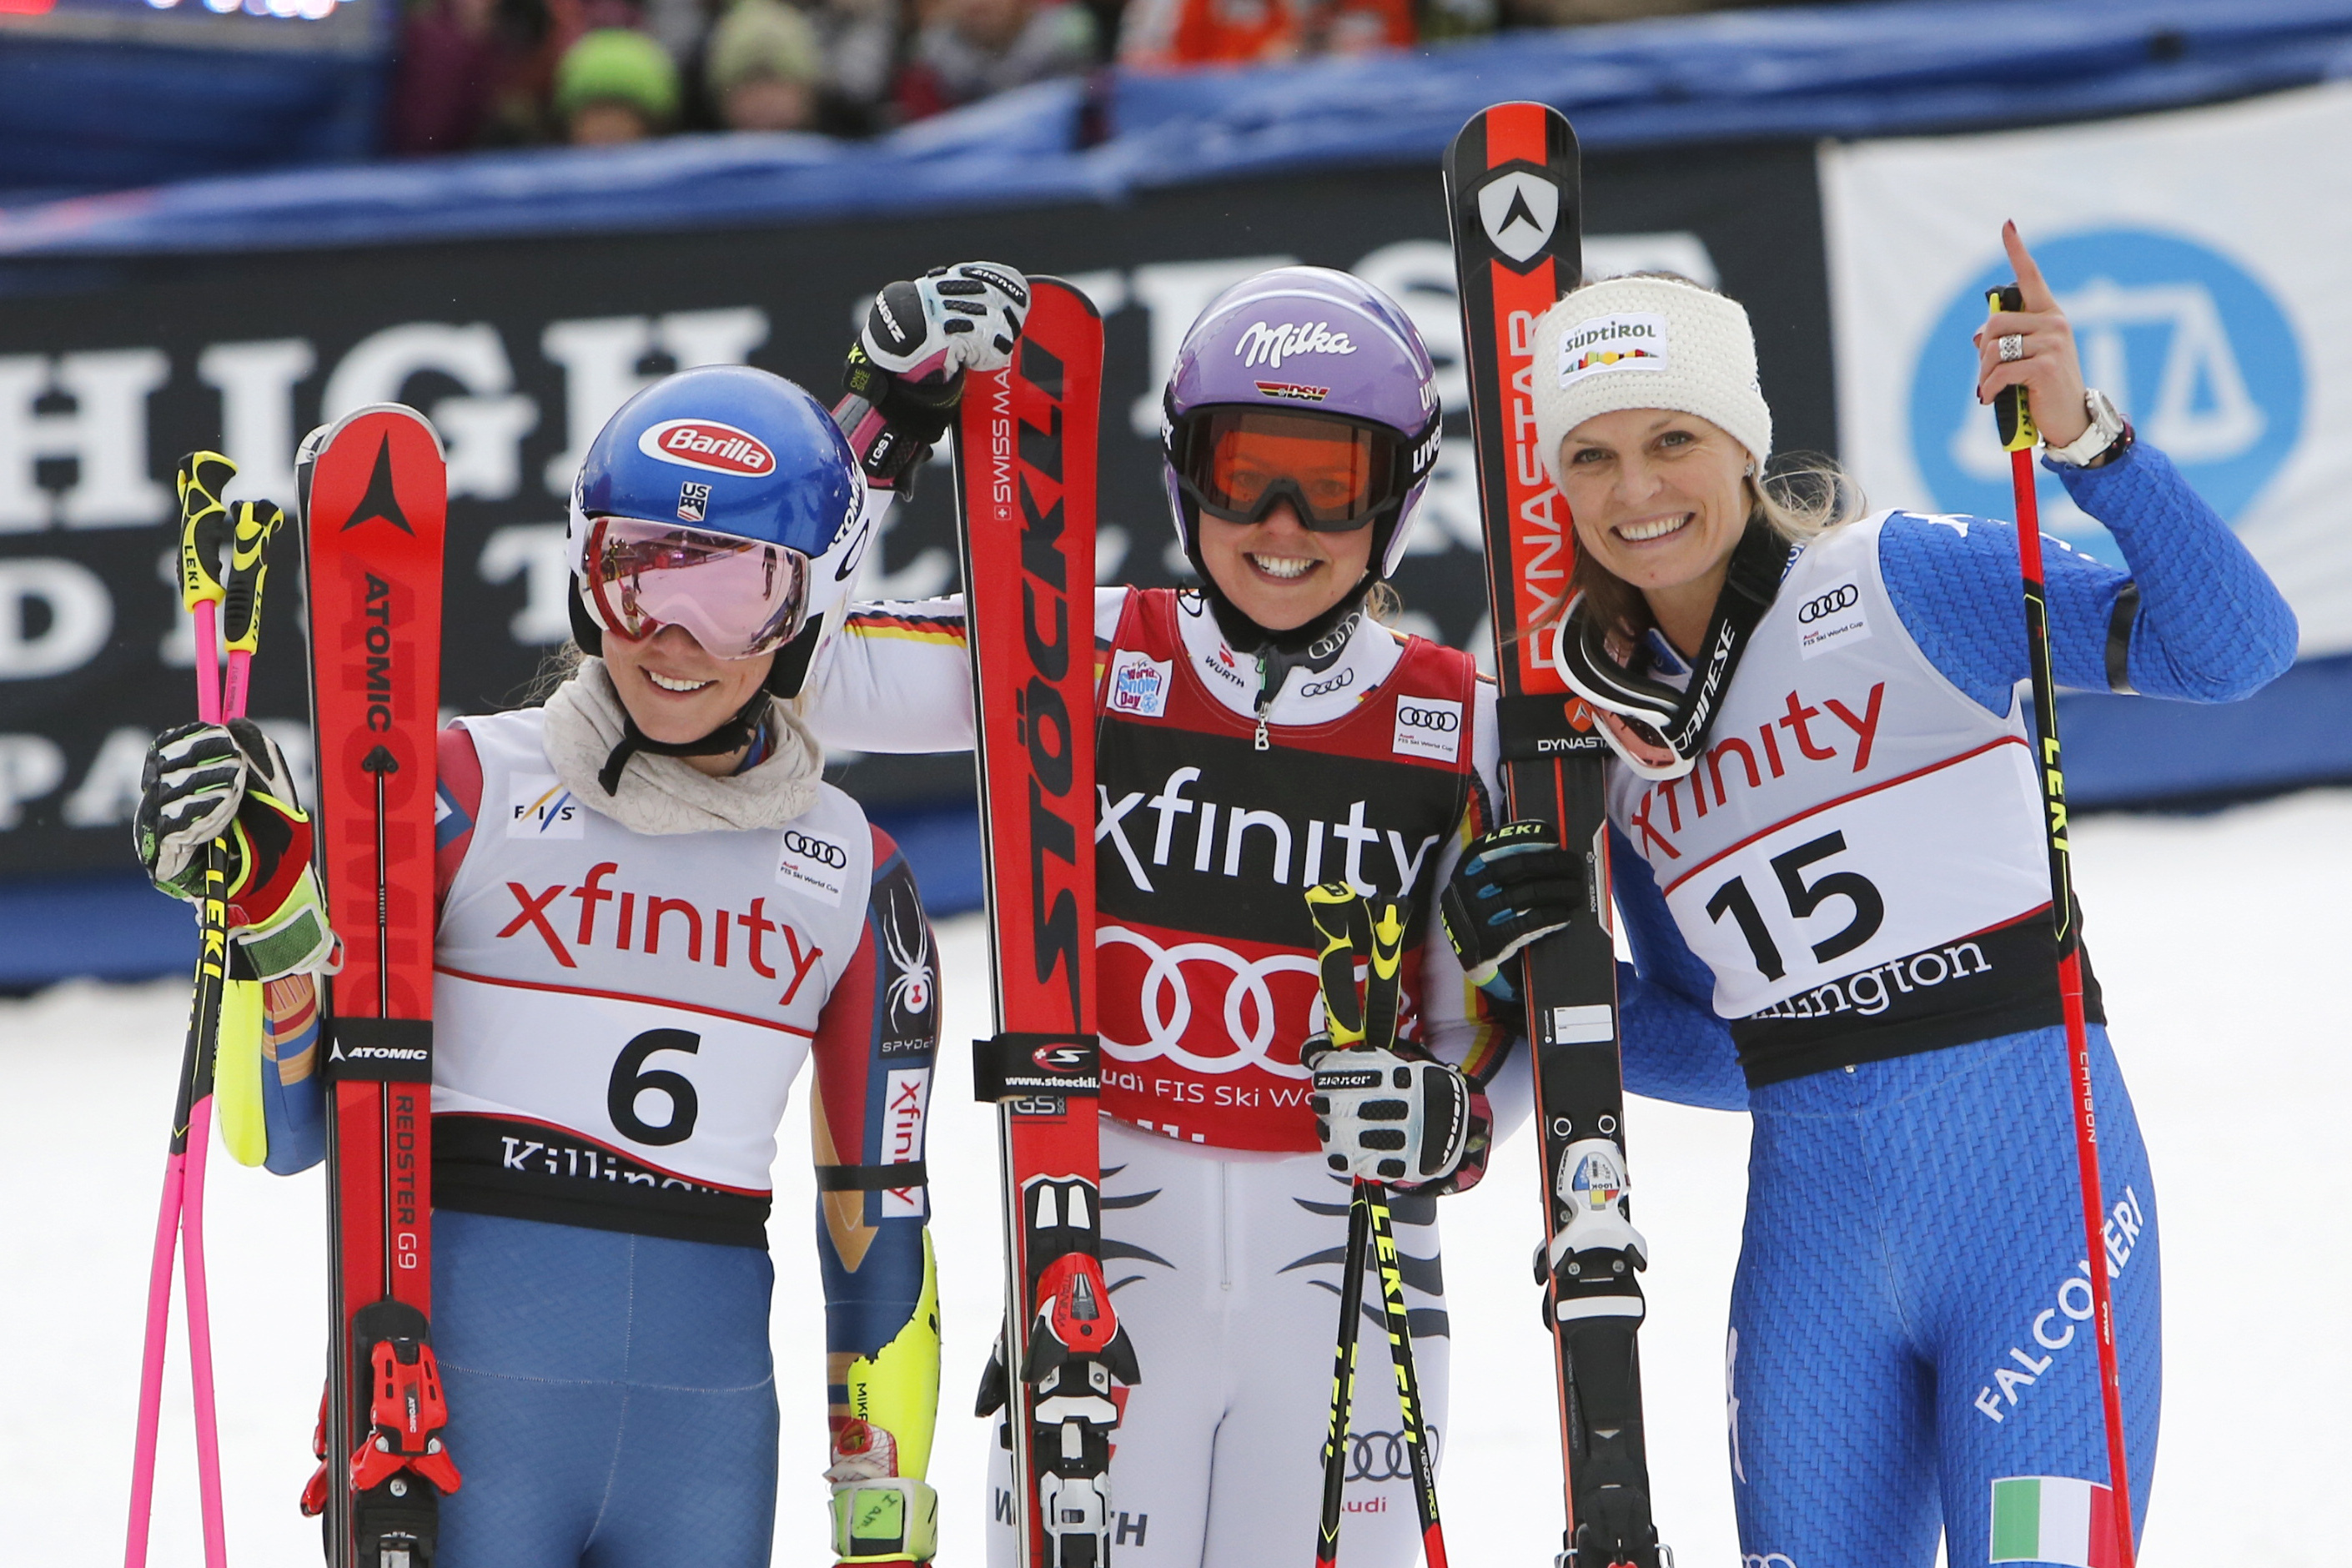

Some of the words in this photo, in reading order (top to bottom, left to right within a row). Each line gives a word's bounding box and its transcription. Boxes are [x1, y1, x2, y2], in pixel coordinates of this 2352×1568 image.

[1234, 321, 1359, 369] Milka
[850, 368, 863, 389] ONE
[856, 371, 871, 392] SIZE
[666, 427, 767, 470] Barilla
[992, 418, 1012, 503] SWISS
[682, 481, 707, 498] US
[183, 545, 200, 591] LEKI
[1849, 621, 1864, 630] Cup
[364, 571, 392, 732] ATOMIC
[1120, 691, 1141, 709] Day
[1671, 618, 1736, 752] DAINESE
[1441, 744, 1454, 752] Cup
[1631, 681, 1886, 860] xfinity
[2043, 737, 2069, 852] LEKI
[1095, 766, 1440, 897] xfinity
[1485, 824, 1541, 844] LEKI
[826, 883, 839, 894] Cup
[1705, 829, 1885, 983] 15
[203, 869, 226, 980] LEKI
[495, 862, 824, 1006] xfinity
[348, 1046, 428, 1061] ATOMIC
[607, 1028, 701, 1147] 6
[1013, 1094, 1057, 1115] GS
[1099, 1071, 1144, 1093] udi
[1154, 1078, 1204, 1103] FIS
[1214, 1086, 1260, 1108] Ski
[2079, 1051, 2098, 1143] CARBON
[395, 1094, 415, 1225] REDSTER
[398, 1231, 417, 1270] G9
[1370, 1204, 1406, 1317] LEKI
[407, 1396, 417, 1434] ATOMIC
[1339, 1496, 1388, 1514] udi
[1420, 1446, 1433, 1488] VENOM
[1427, 1489, 1438, 1520] RACE
